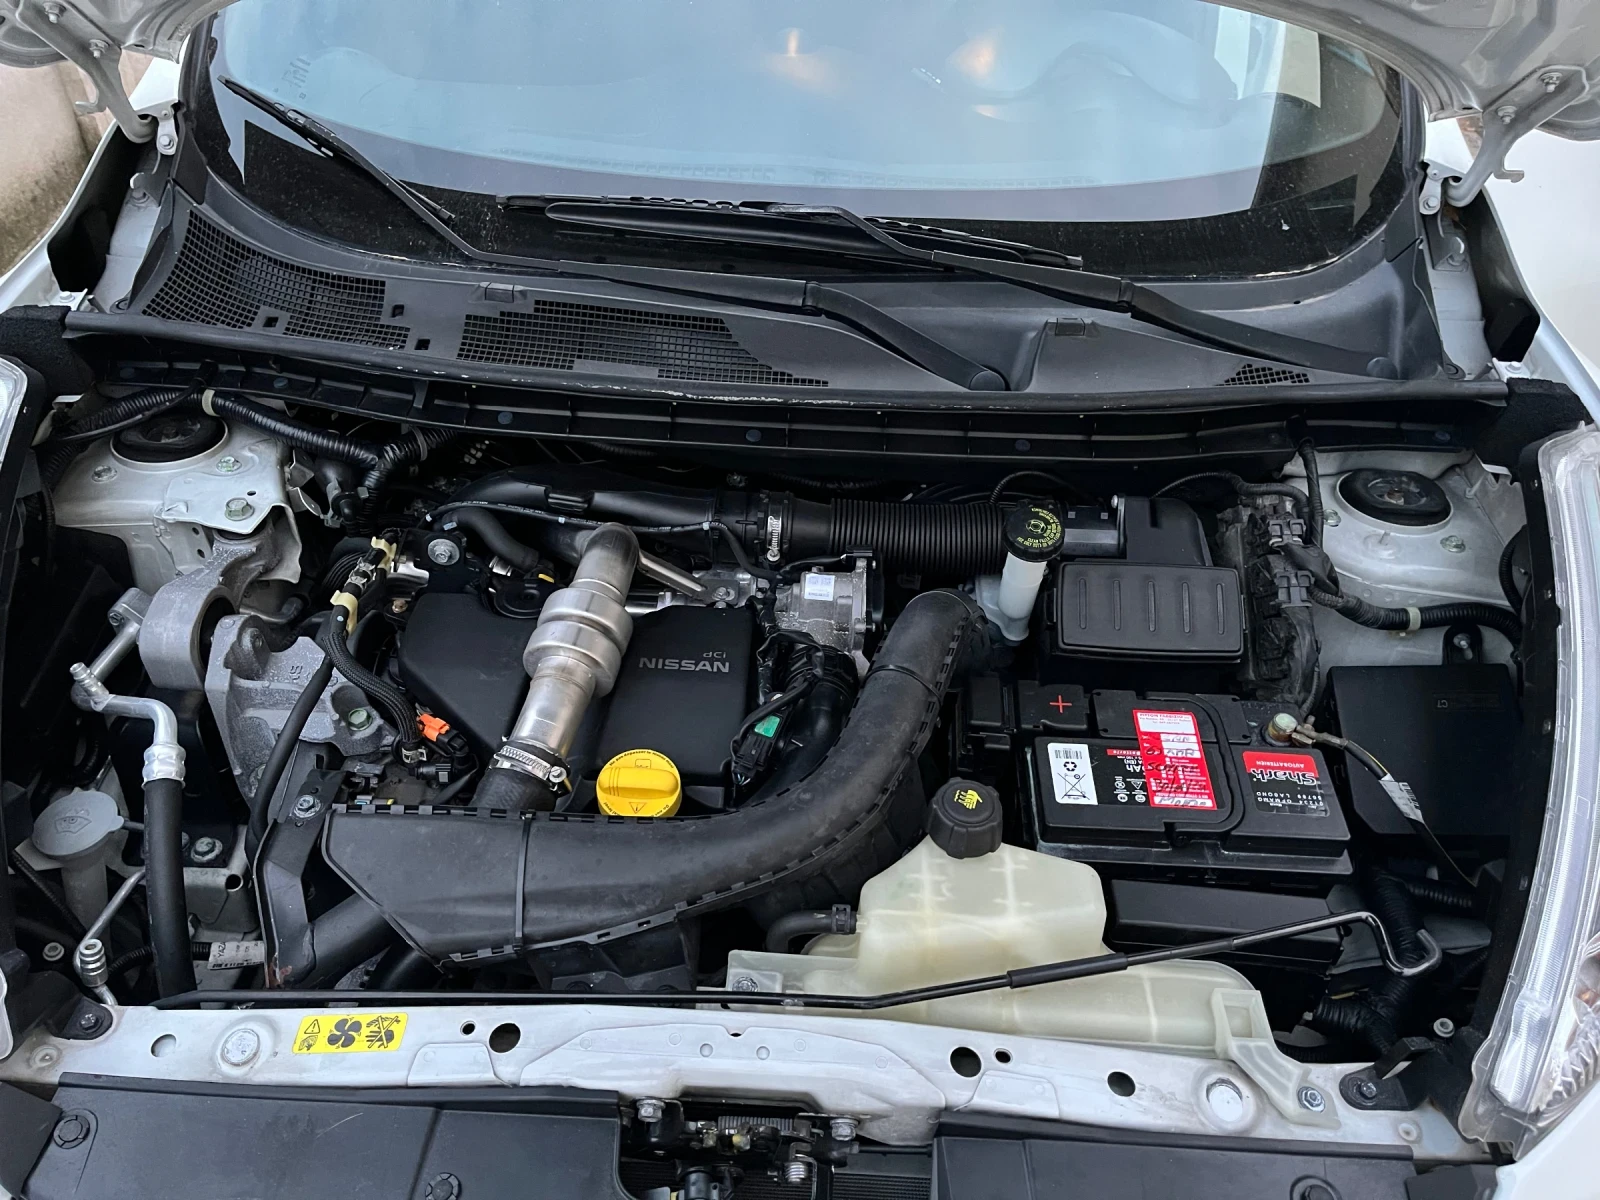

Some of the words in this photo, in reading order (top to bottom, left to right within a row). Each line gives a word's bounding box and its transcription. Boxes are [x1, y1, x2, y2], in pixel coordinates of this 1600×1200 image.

[639, 657, 730, 673] NISSAN
[1256, 760, 1304, 768] AUTOBATTERIEN
[1250, 768, 1317, 786] Shark
